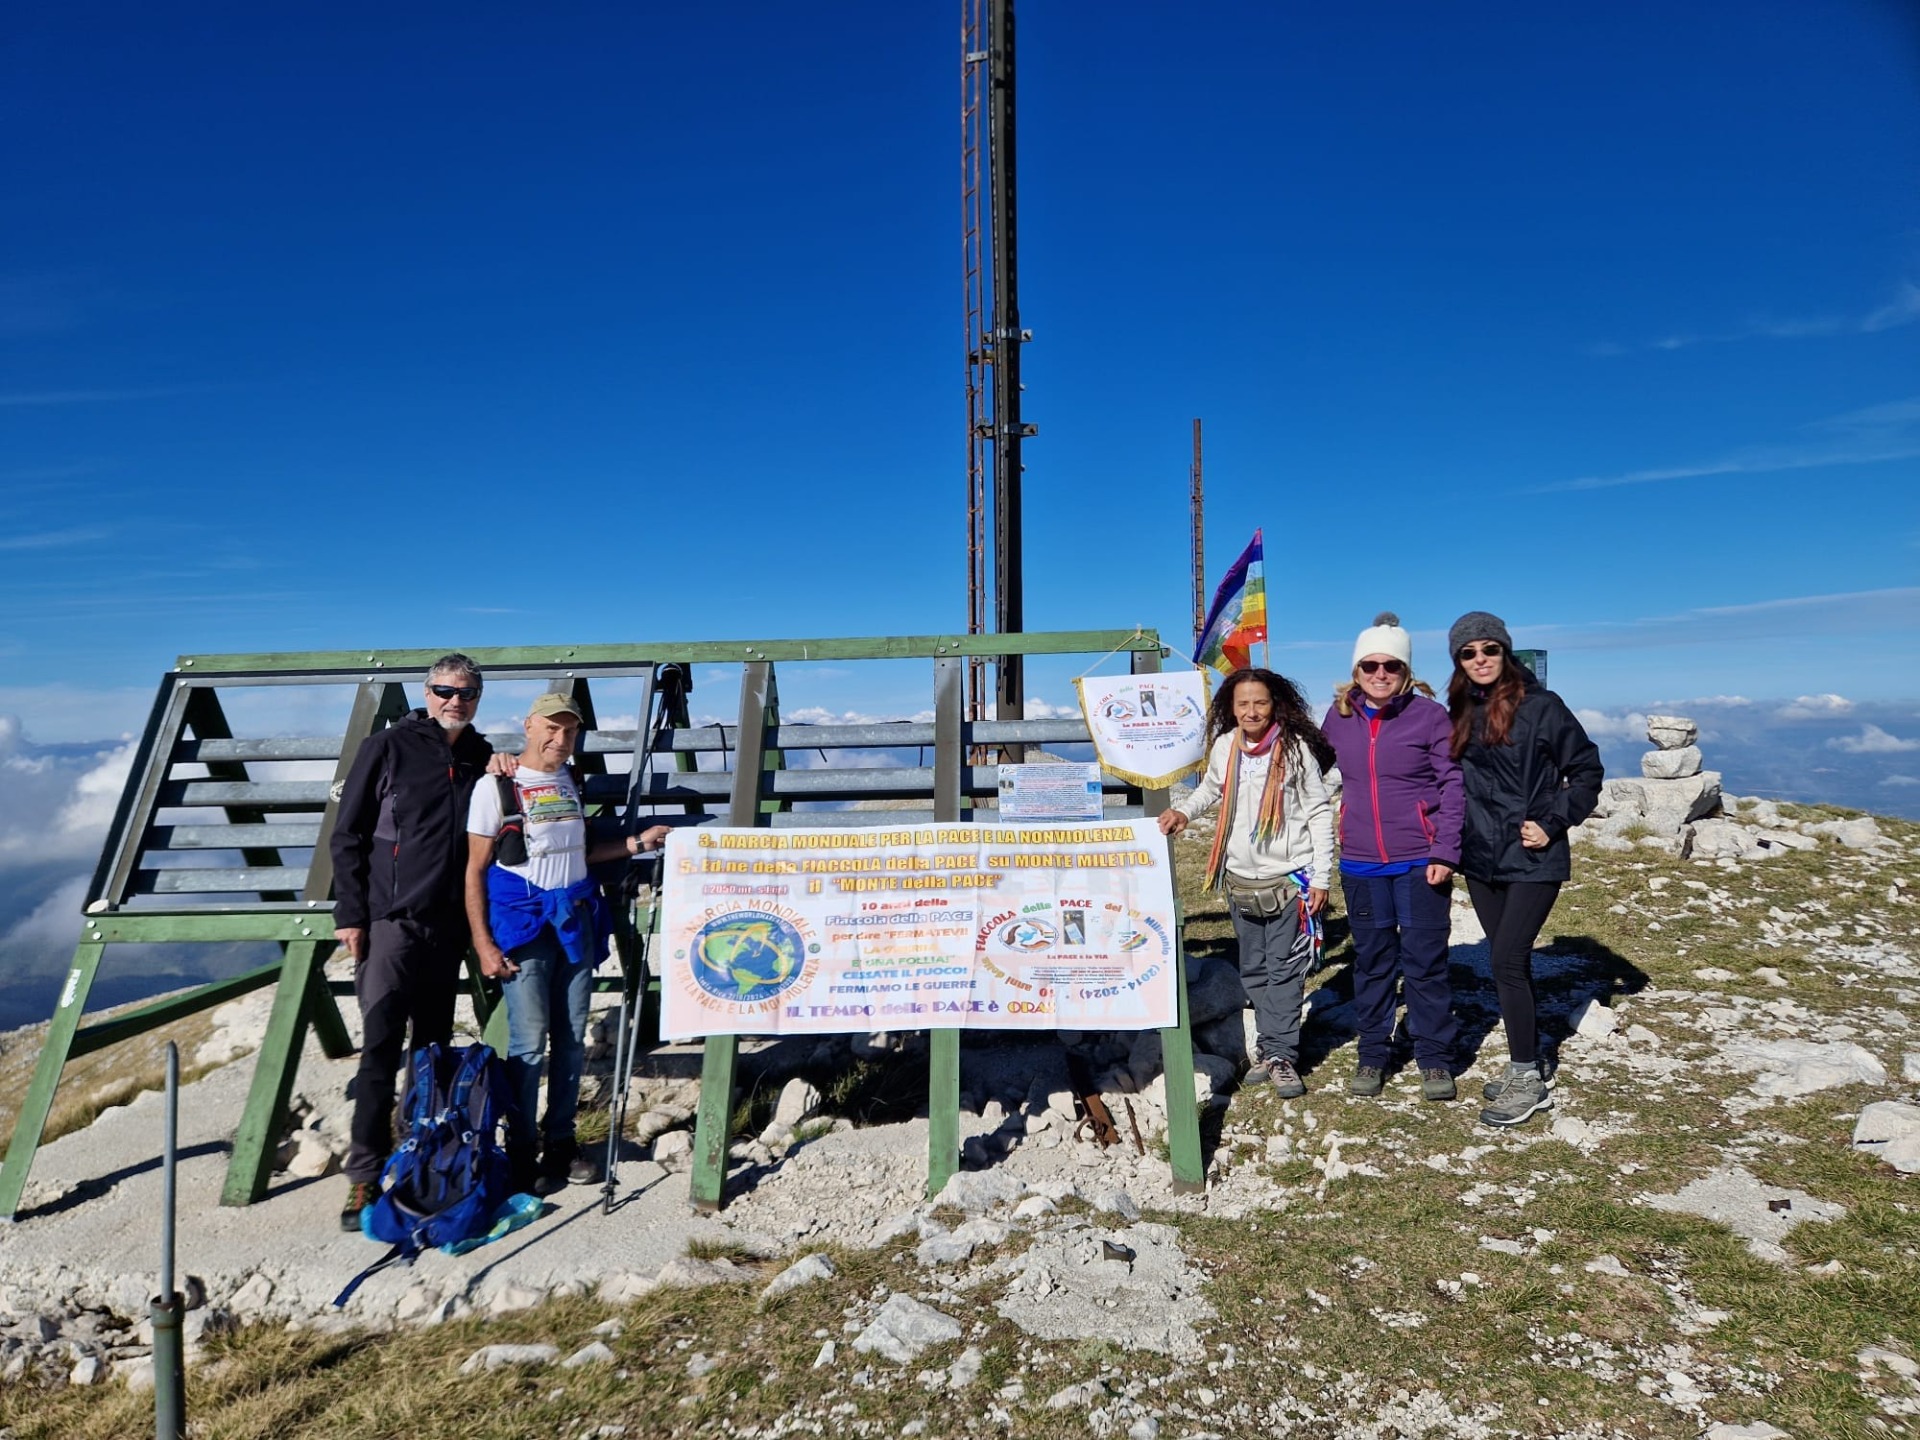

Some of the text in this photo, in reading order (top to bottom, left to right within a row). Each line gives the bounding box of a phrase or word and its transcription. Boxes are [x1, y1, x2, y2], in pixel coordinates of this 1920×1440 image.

[529, 788, 557, 798] PACE
[721, 834, 788, 849] MARCIA
[792, 833, 877, 849] MONDIALE
[879, 831, 911, 847] PER
[914, 830, 934, 845] LA
[937, 828, 981, 844] PACE
[983, 829, 993, 844] E
[996, 829, 1016, 844] LA
[1019, 826, 1135, 844] NONVIOLENZA
[701, 858, 749, 873] Ed.ne
[753, 859, 798, 874] della
[801, 857, 881, 873] FIACCOLA
[885, 855, 930, 871] della
[934, 854, 978, 870] PACE
[988, 855, 1011, 868] su
[1014, 853, 1073, 868] MONTE
[1076, 851, 1155, 868] MILETTO,
[808, 873, 1003, 894] il "MONTE della PACE"
[861, 898, 948, 911] 10 anni della
[1022, 902, 1053, 914] della
[1060, 899, 1093, 908] PACE
[1104, 902, 1123, 913] del
[748, 899, 817, 941] MONDIALE
[824, 911, 973, 926] Fiaccola della PACE
[832, 932, 851, 942] per
[855, 931, 880, 940] dire
[975, 910, 1017, 951] FIACCOLA
[1144, 916, 1171, 956] Millennio
[842, 966, 968, 980] CESSATE IL FUOCO!
[1128, 964, 1161, 991] (2014
[829, 980, 977, 994] FERMIAMO LE GUERRE
[1004, 976, 1033, 992] anni
[1079, 985, 1120, 1000] 2024)
[695, 990, 723, 1012] PACE
[739, 1003, 756, 1015] LA
[786, 1006, 804, 1018] IL
[807, 1004, 876, 1018] TEMPO
[880, 1001, 928, 1015] della
[932, 1000, 985, 1013] PACE
[988, 999, 999, 1013] è
